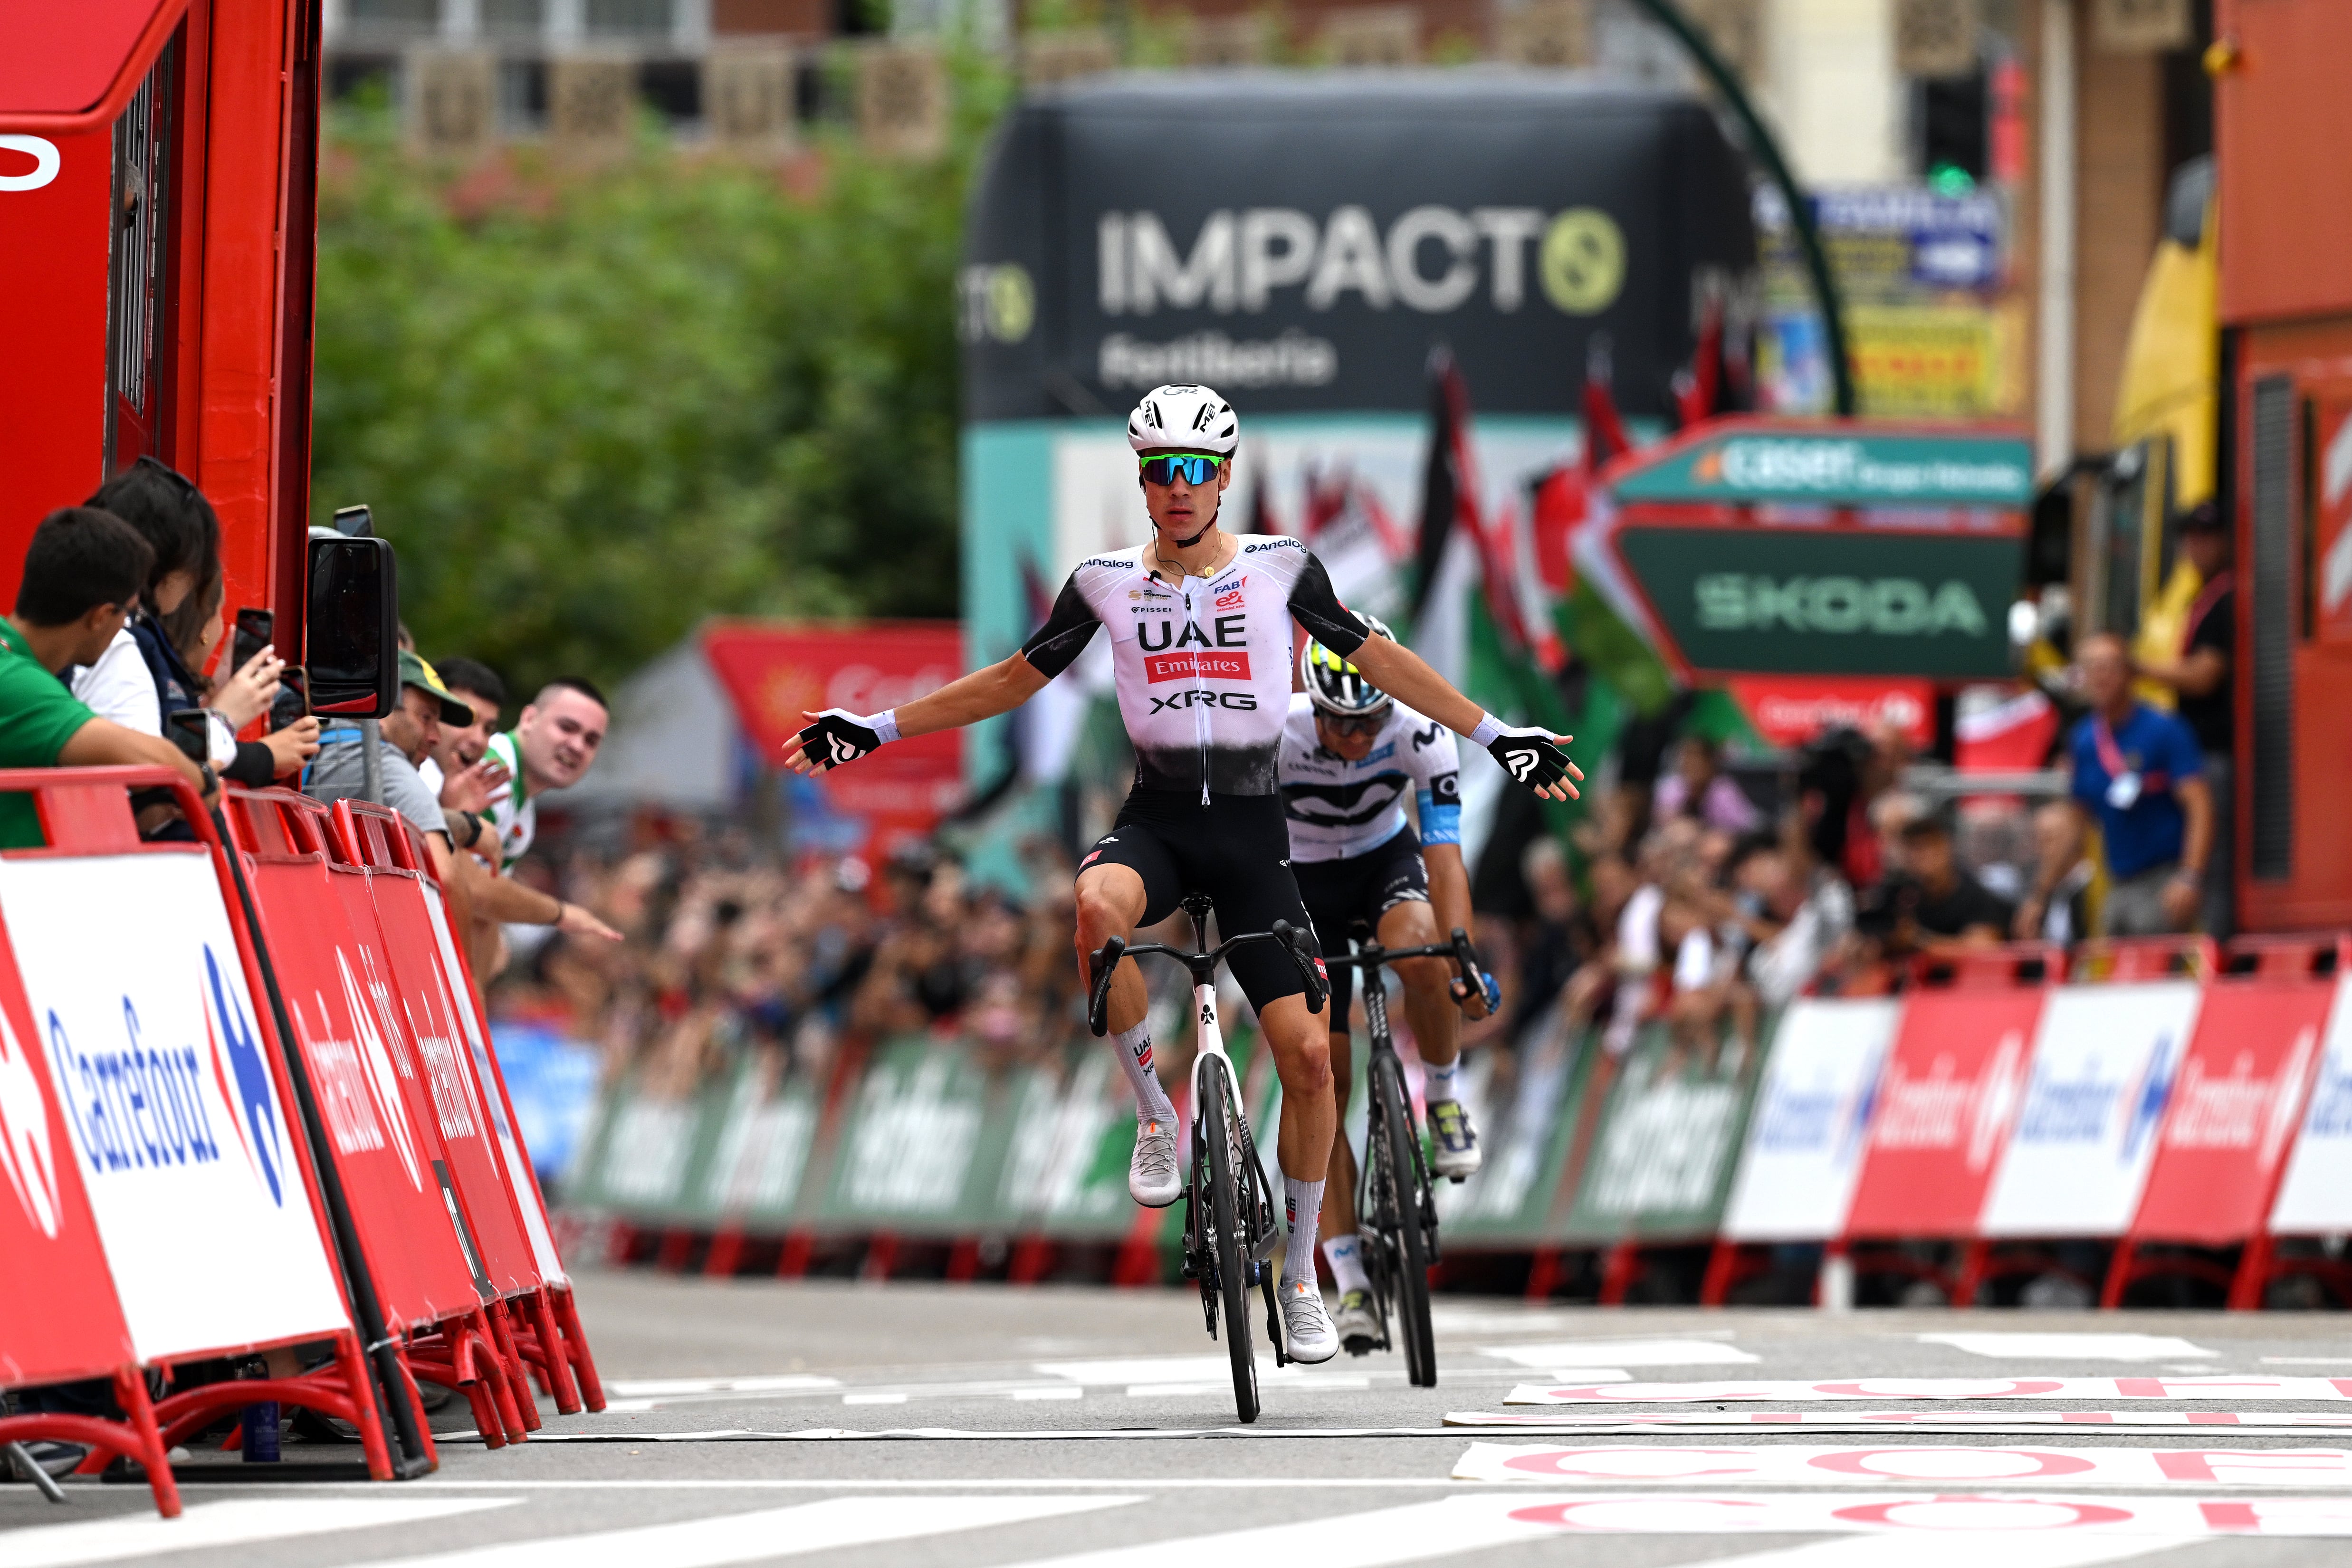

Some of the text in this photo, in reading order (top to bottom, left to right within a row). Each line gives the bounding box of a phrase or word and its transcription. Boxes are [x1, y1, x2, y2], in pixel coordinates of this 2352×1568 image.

[1163, 388, 1198, 396] G42
[1144, 400, 1156, 429] MET
[1199, 401, 1215, 433] MET
[1258, 538, 1307, 554] Analog
[1083, 558, 1134, 569] Analog
[1214, 581, 1240, 594] FAB
[1138, 614, 1247, 652] UAE
[1155, 658, 1241, 675] Emirates
[1149, 689, 1257, 715] XRG
[48, 994, 220, 1175] Carrefour
